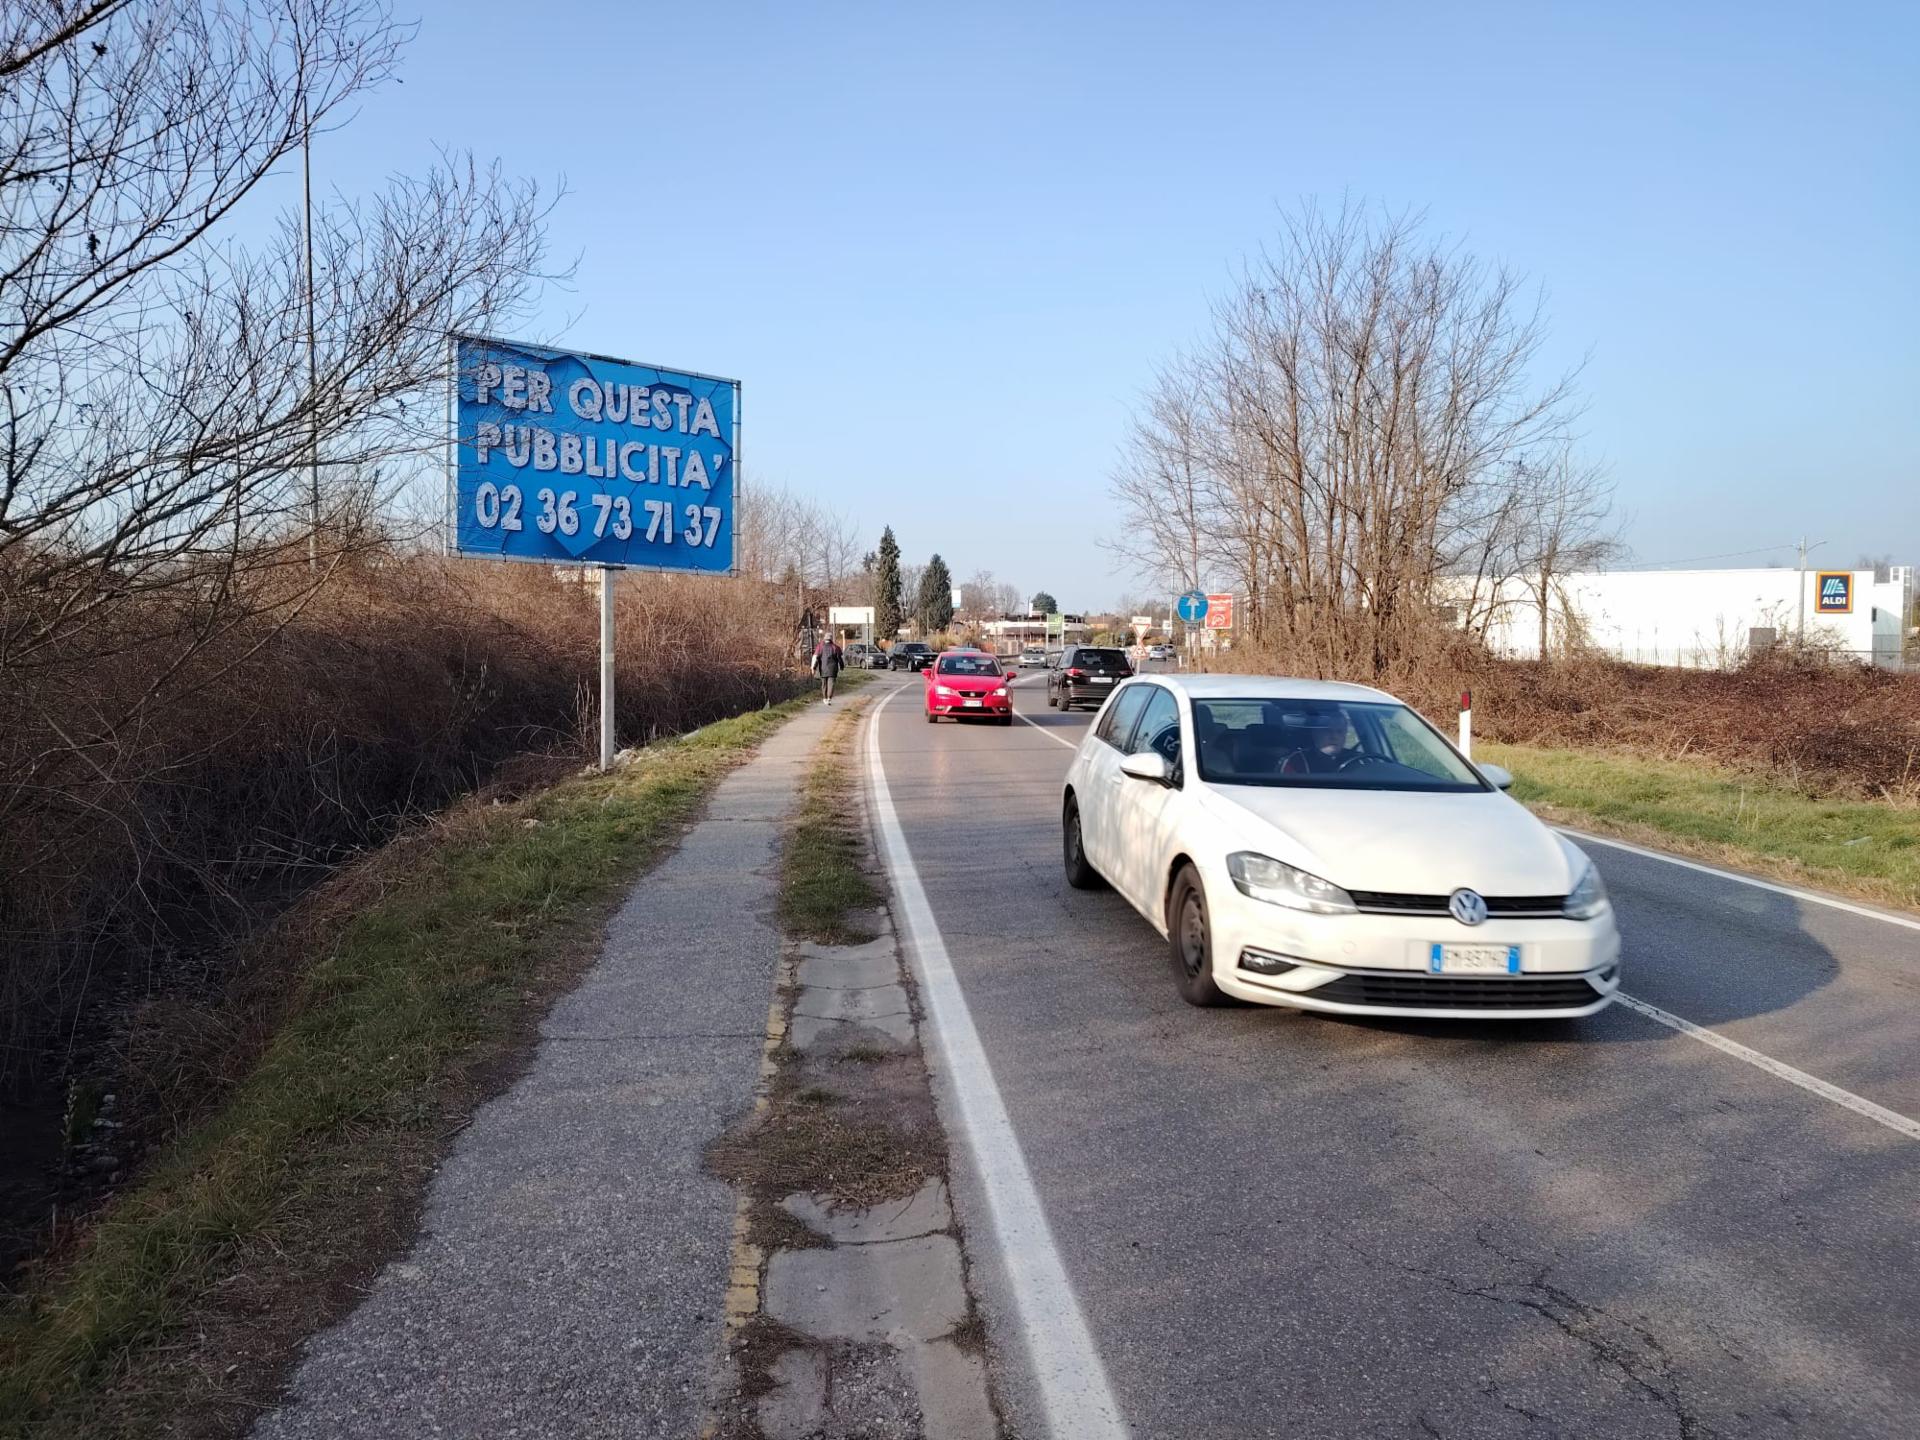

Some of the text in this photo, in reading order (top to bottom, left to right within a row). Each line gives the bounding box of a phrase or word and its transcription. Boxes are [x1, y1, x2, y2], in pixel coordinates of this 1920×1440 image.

[476, 364, 721, 438] PER QUESTA
[475, 481, 722, 548] 02 36 73 71 37
[1822, 596, 1846, 605] ALDI
